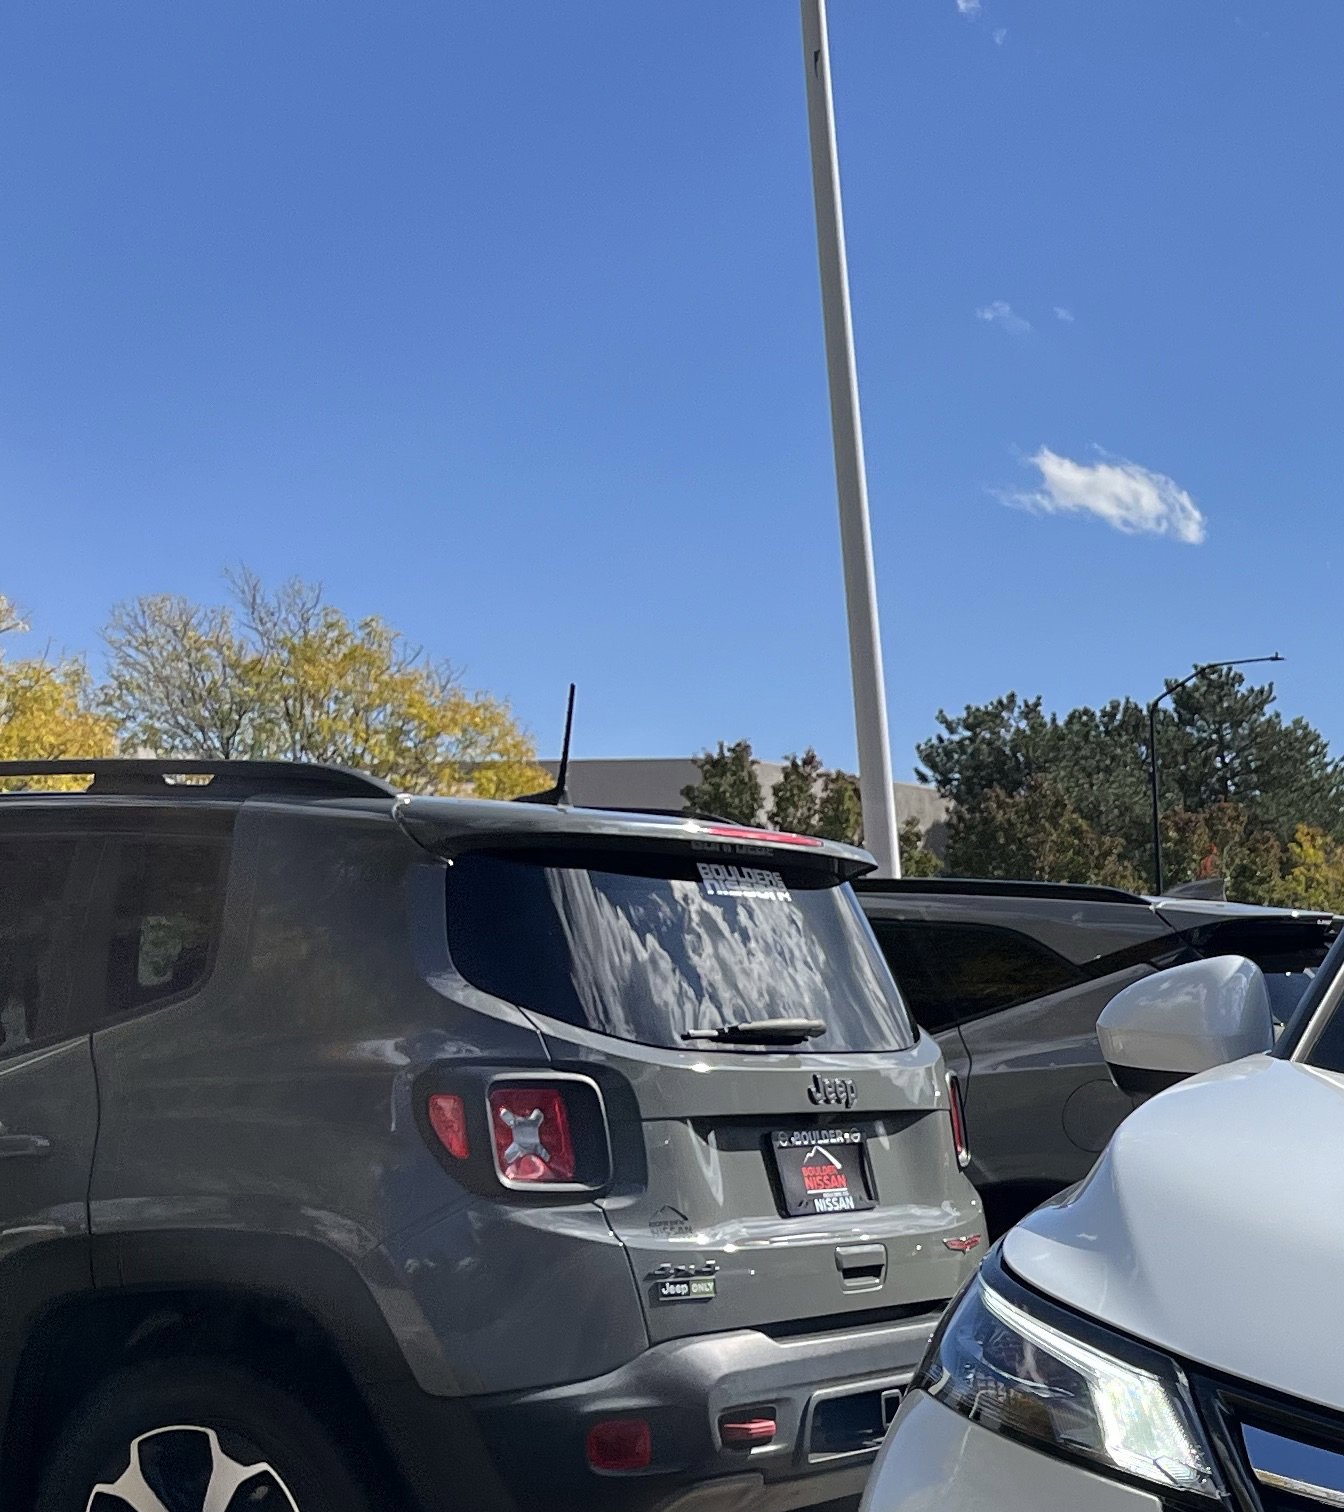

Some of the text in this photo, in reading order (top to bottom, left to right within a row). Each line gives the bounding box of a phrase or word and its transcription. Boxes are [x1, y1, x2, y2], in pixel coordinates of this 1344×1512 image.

[807, 1073, 857, 1108] Jeep
[792, 1130, 844, 1145] BOULDER
[804, 1174, 848, 1190] NISSAN
[814, 1196, 855, 1212] NISSAN
[661, 1282, 714, 1295] Jeep ONLY
